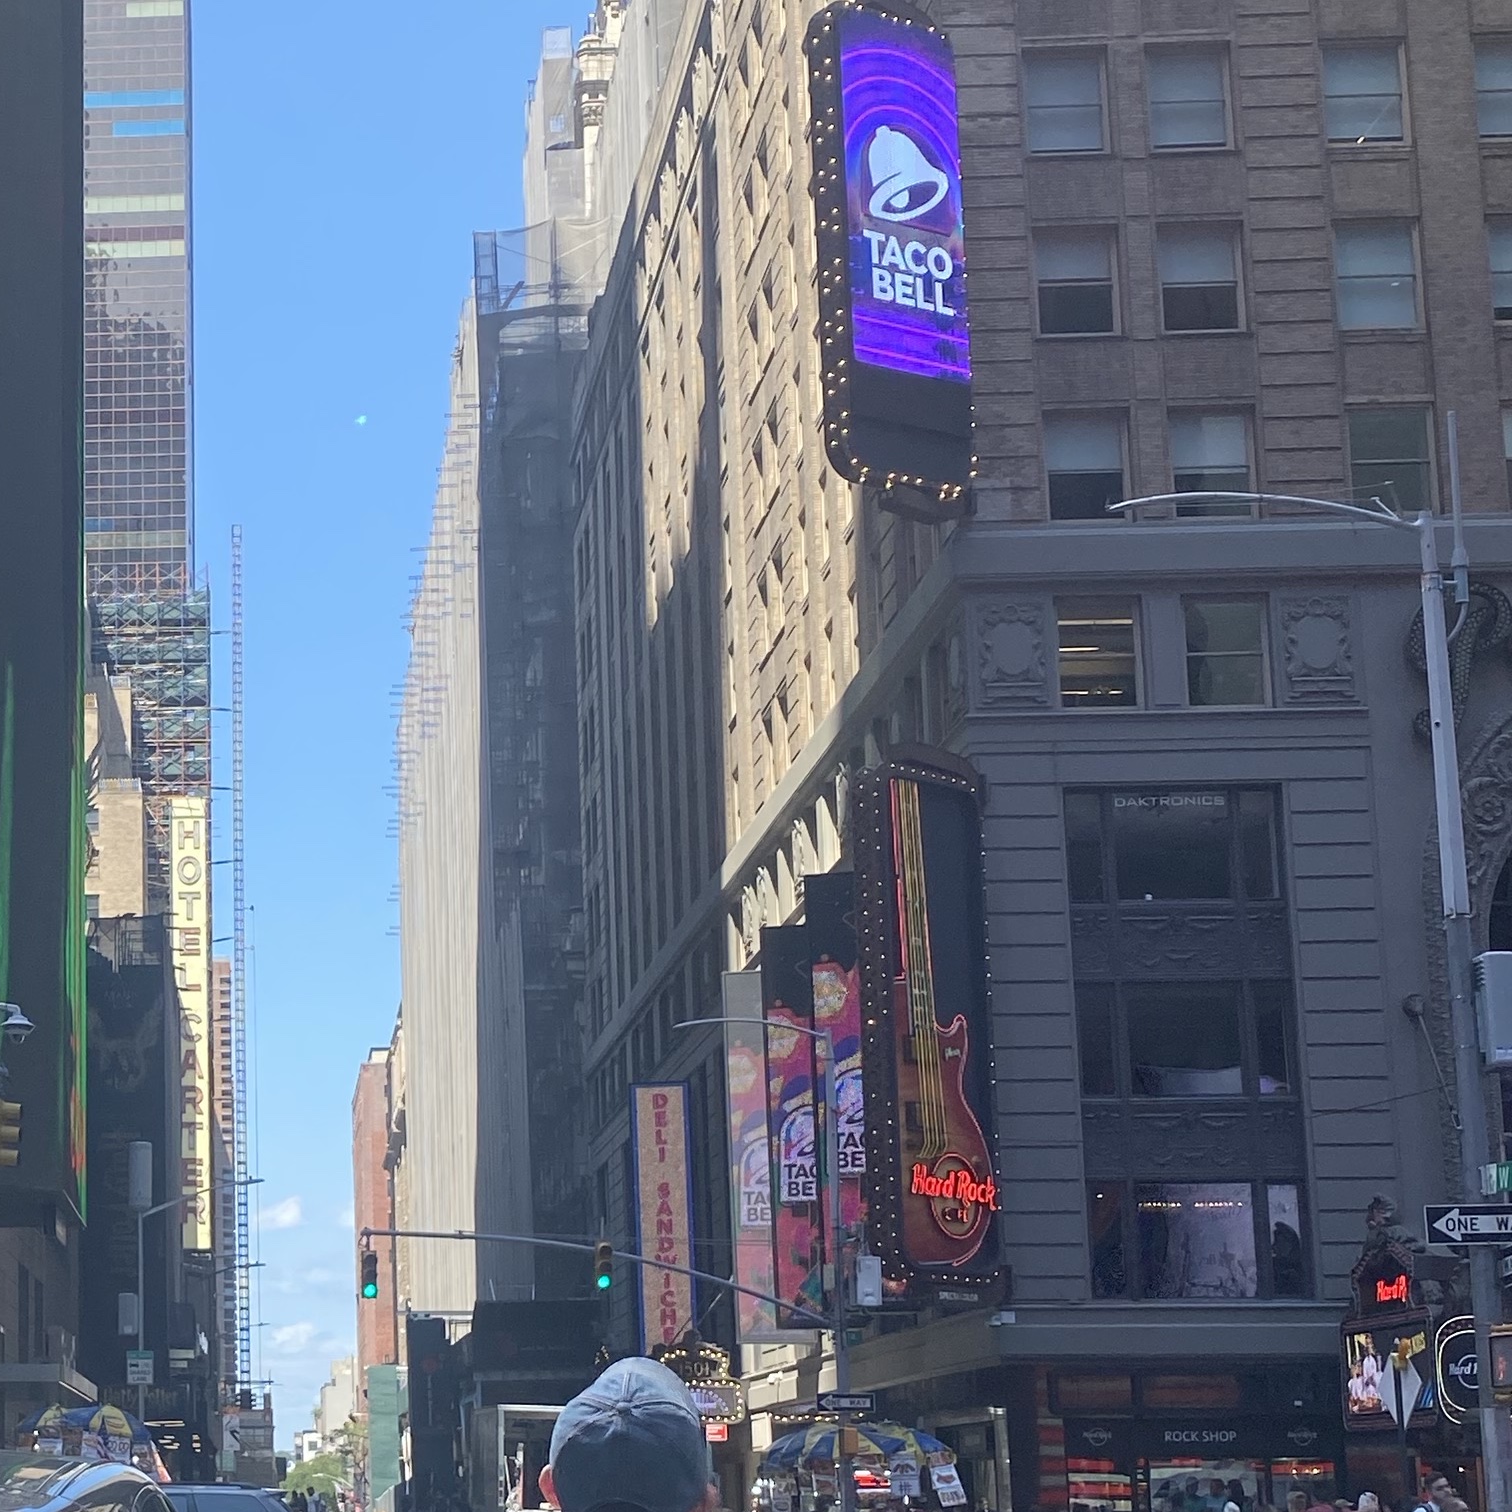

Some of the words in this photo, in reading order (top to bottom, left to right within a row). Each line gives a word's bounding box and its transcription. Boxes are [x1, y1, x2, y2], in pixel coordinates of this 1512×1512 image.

[862, 229, 953, 280] TACO
[872, 267, 955, 316] BELL
[1114, 796, 1225, 807] DAKTRONICS
[177, 820, 202, 993] HOTEL
[179, 1013, 206, 1225] CARTER
[652, 1092, 669, 1163] DELI
[911, 1163, 955, 1198] Hard
[956, 1169, 998, 1211] Rock
[1446, 1216, 1480, 1232] ONE
[1496, 1216, 1512, 1231] W
[849, 1399, 867, 1407] WAY
[1164, 1430, 1199, 1442] ROCK
[1202, 1430, 1237, 1442] SHOP
